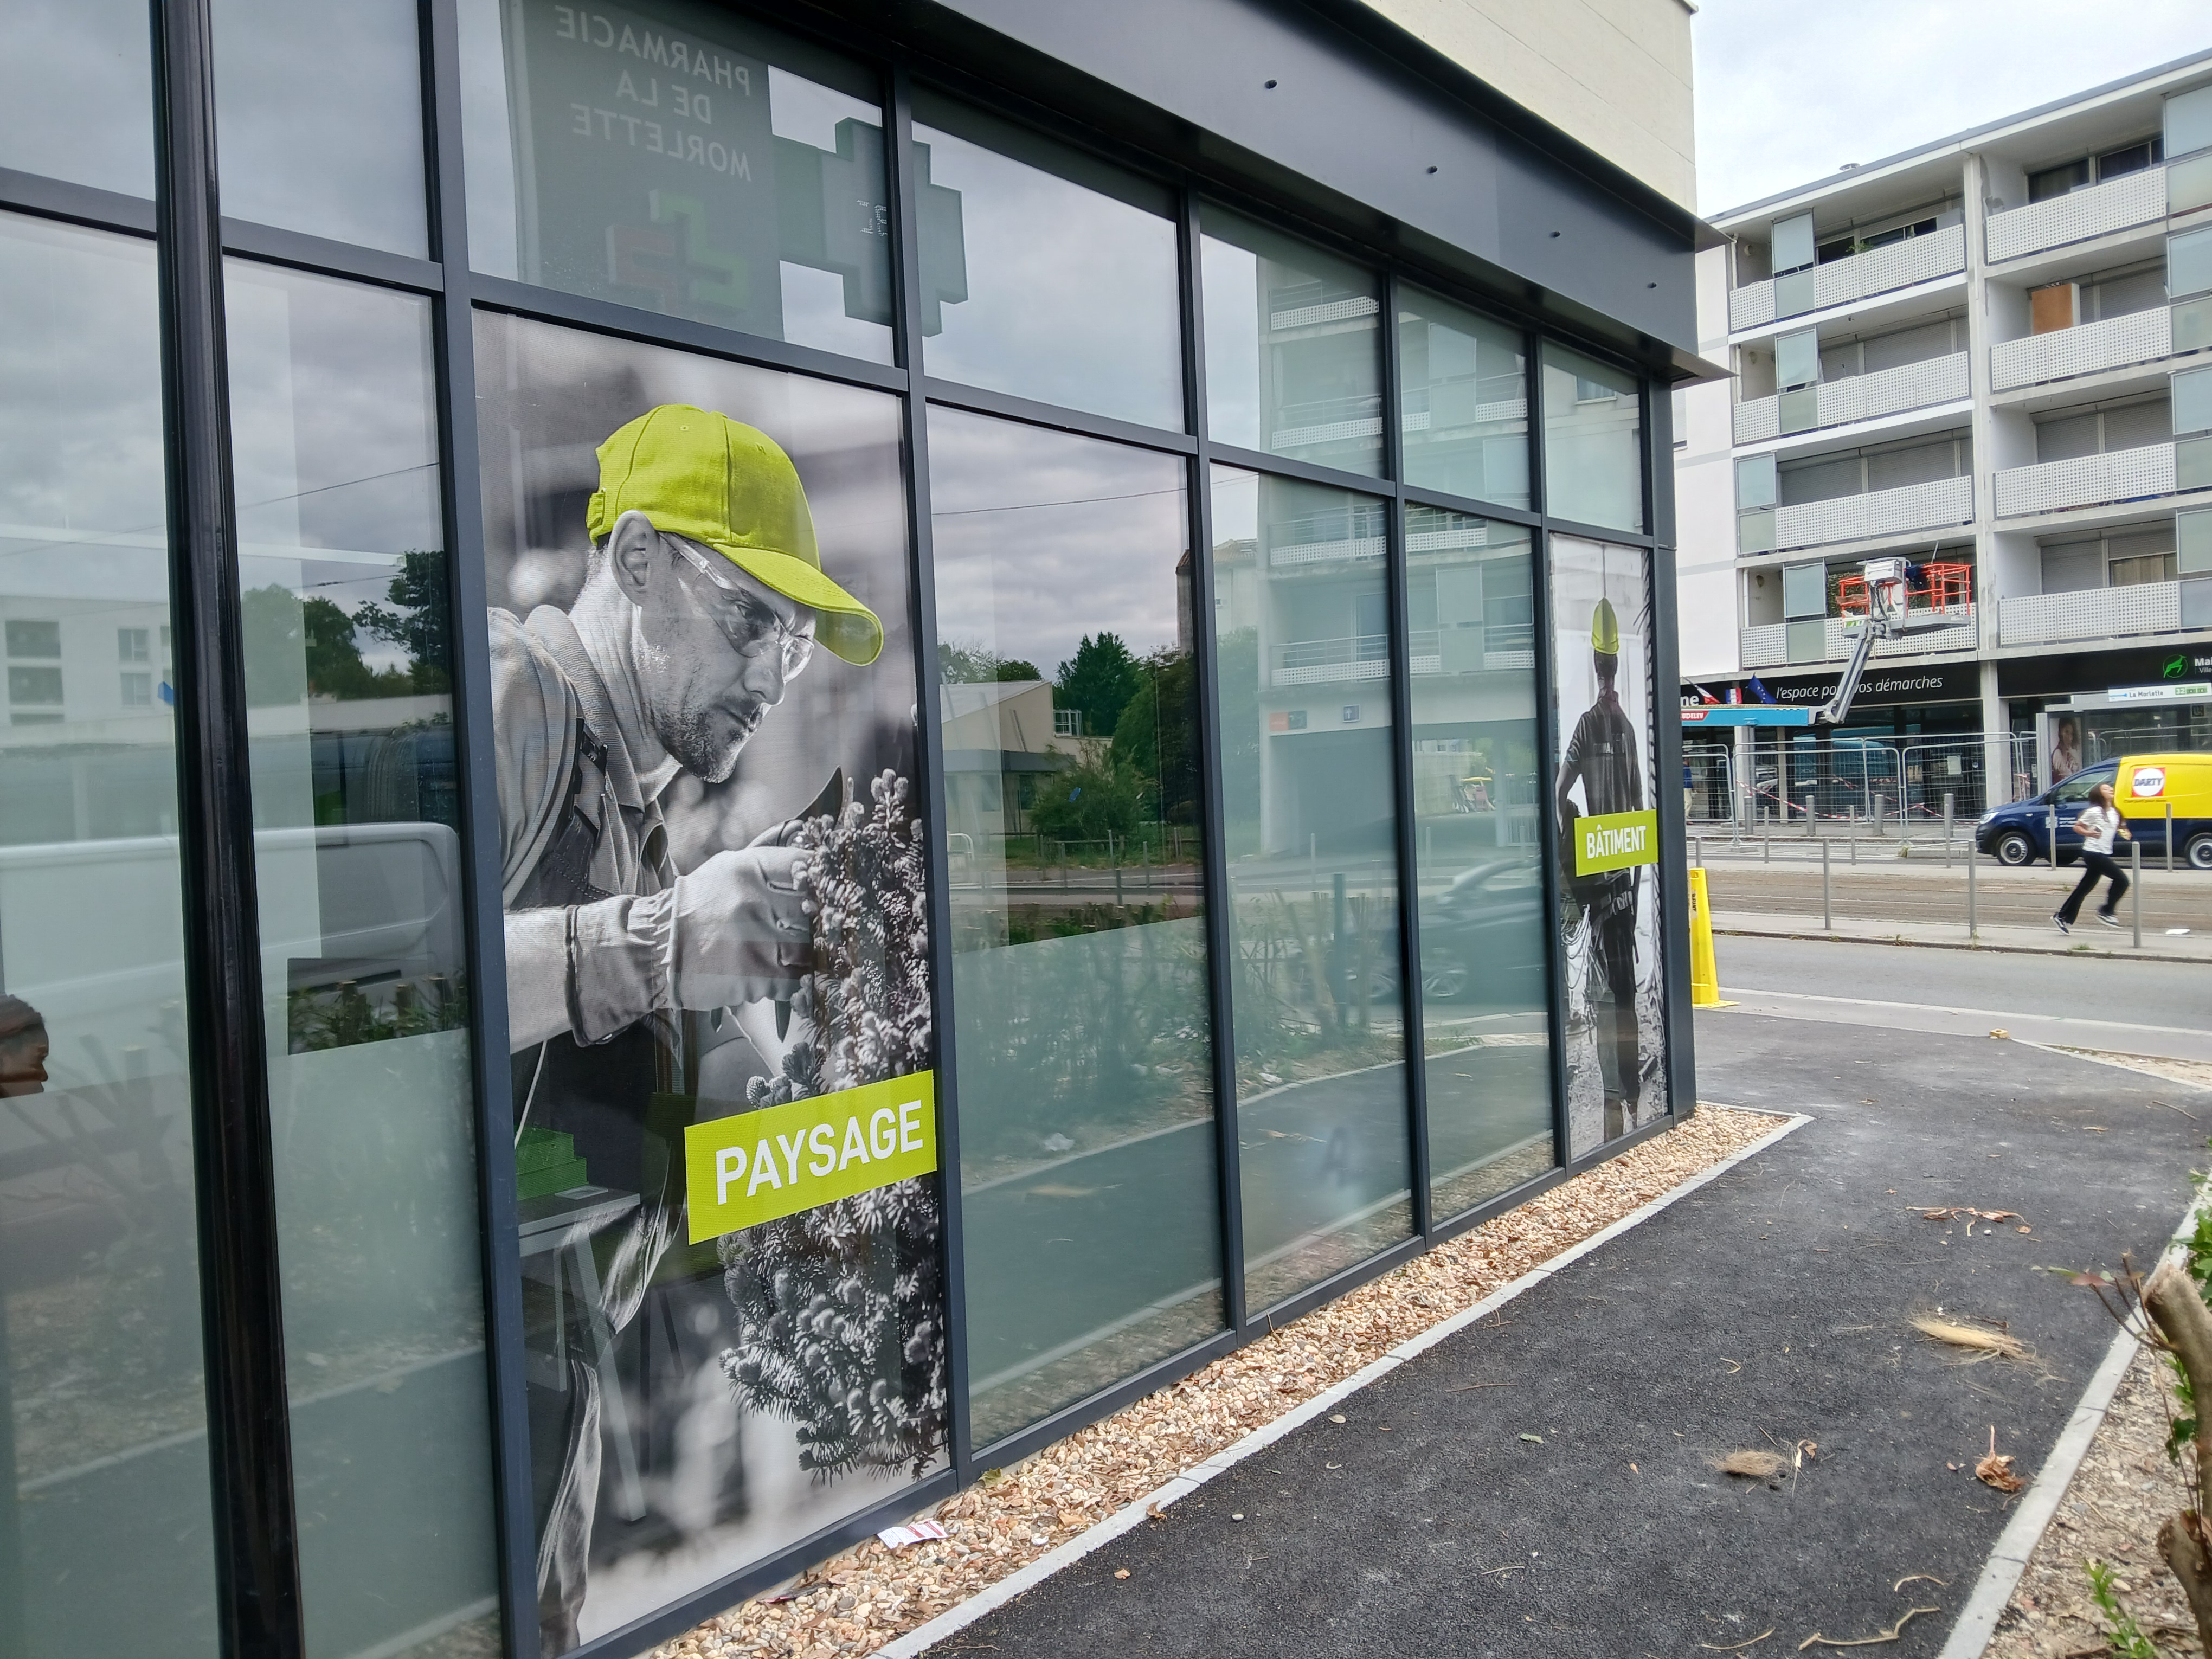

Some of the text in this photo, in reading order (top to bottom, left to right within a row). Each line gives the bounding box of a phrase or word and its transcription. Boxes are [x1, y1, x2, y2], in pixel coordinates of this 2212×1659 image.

[1776, 686, 1819, 702] l'espace
[1875, 675, 1943, 692] démarches
[2134, 777, 2163, 786] DARTY
[1586, 824, 1647, 859] BÂTIMENT
[715, 1099, 924, 1205] PAYSAGE
